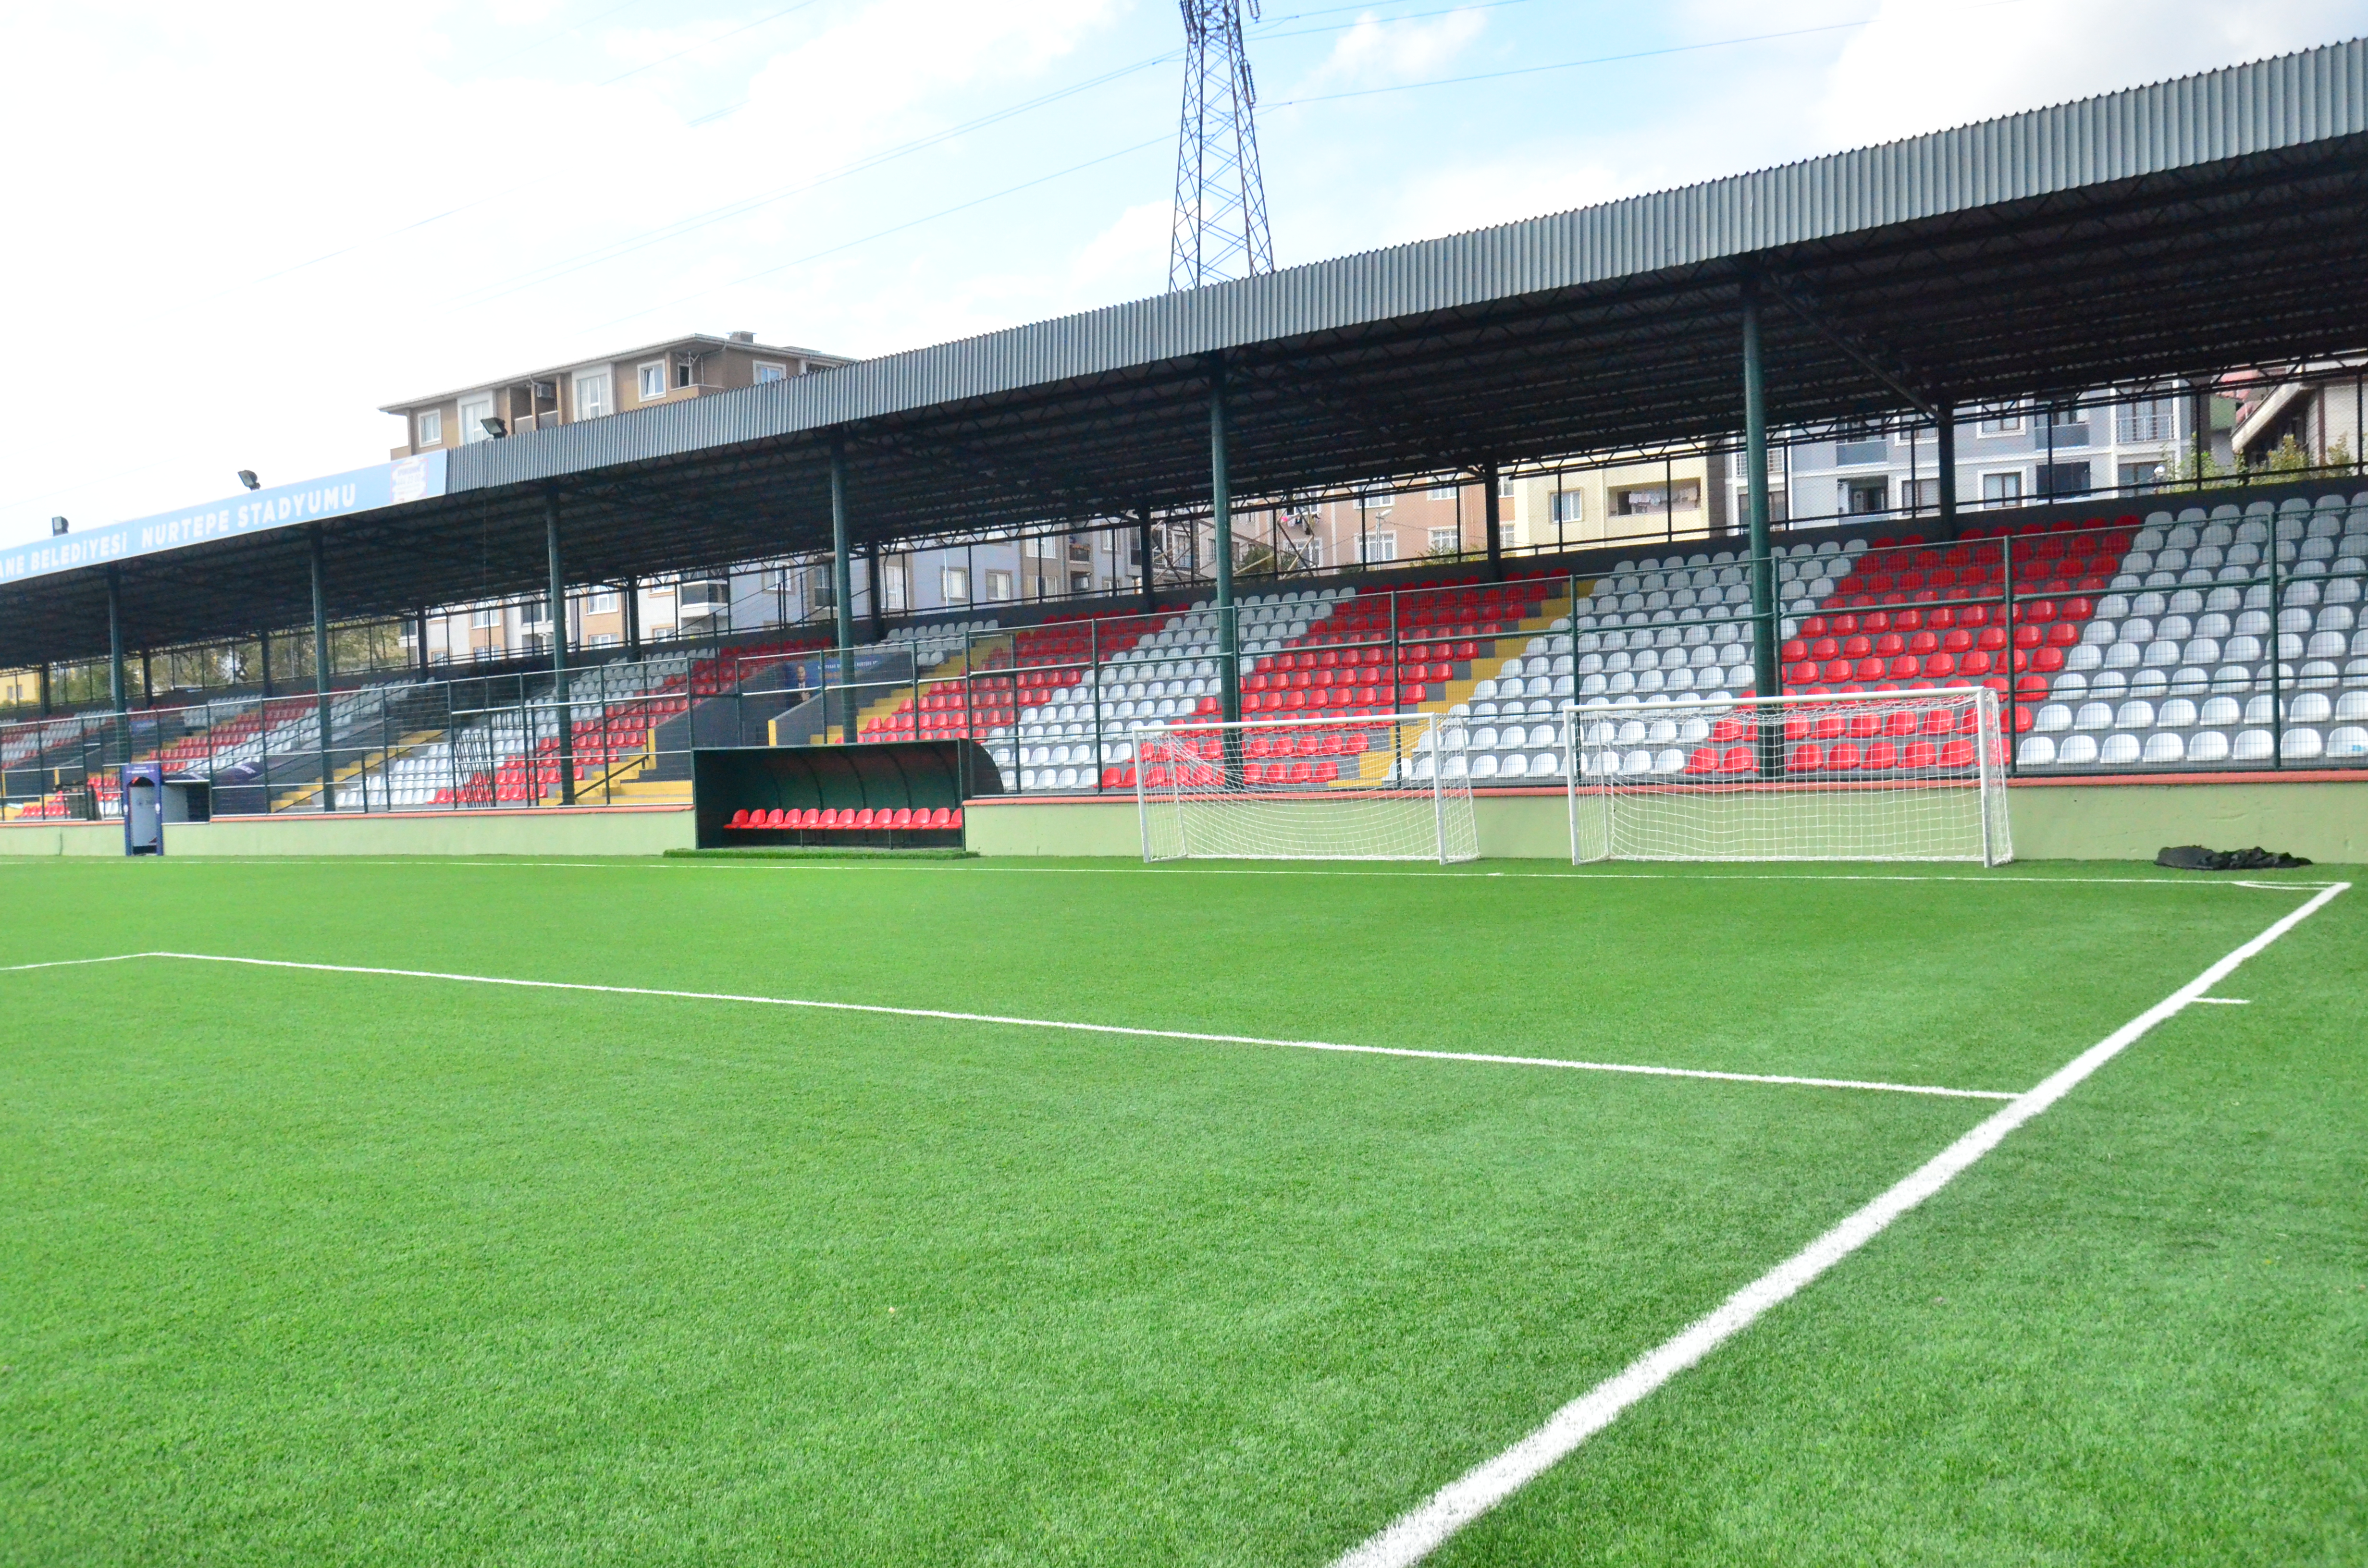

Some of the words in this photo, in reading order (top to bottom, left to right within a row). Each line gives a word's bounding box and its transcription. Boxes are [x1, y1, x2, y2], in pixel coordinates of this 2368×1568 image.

[31, 531, 127, 571] BELEDİYESİ
[142, 509, 229, 548] NURTEPE
[237, 483, 356, 527] STADYUMU
